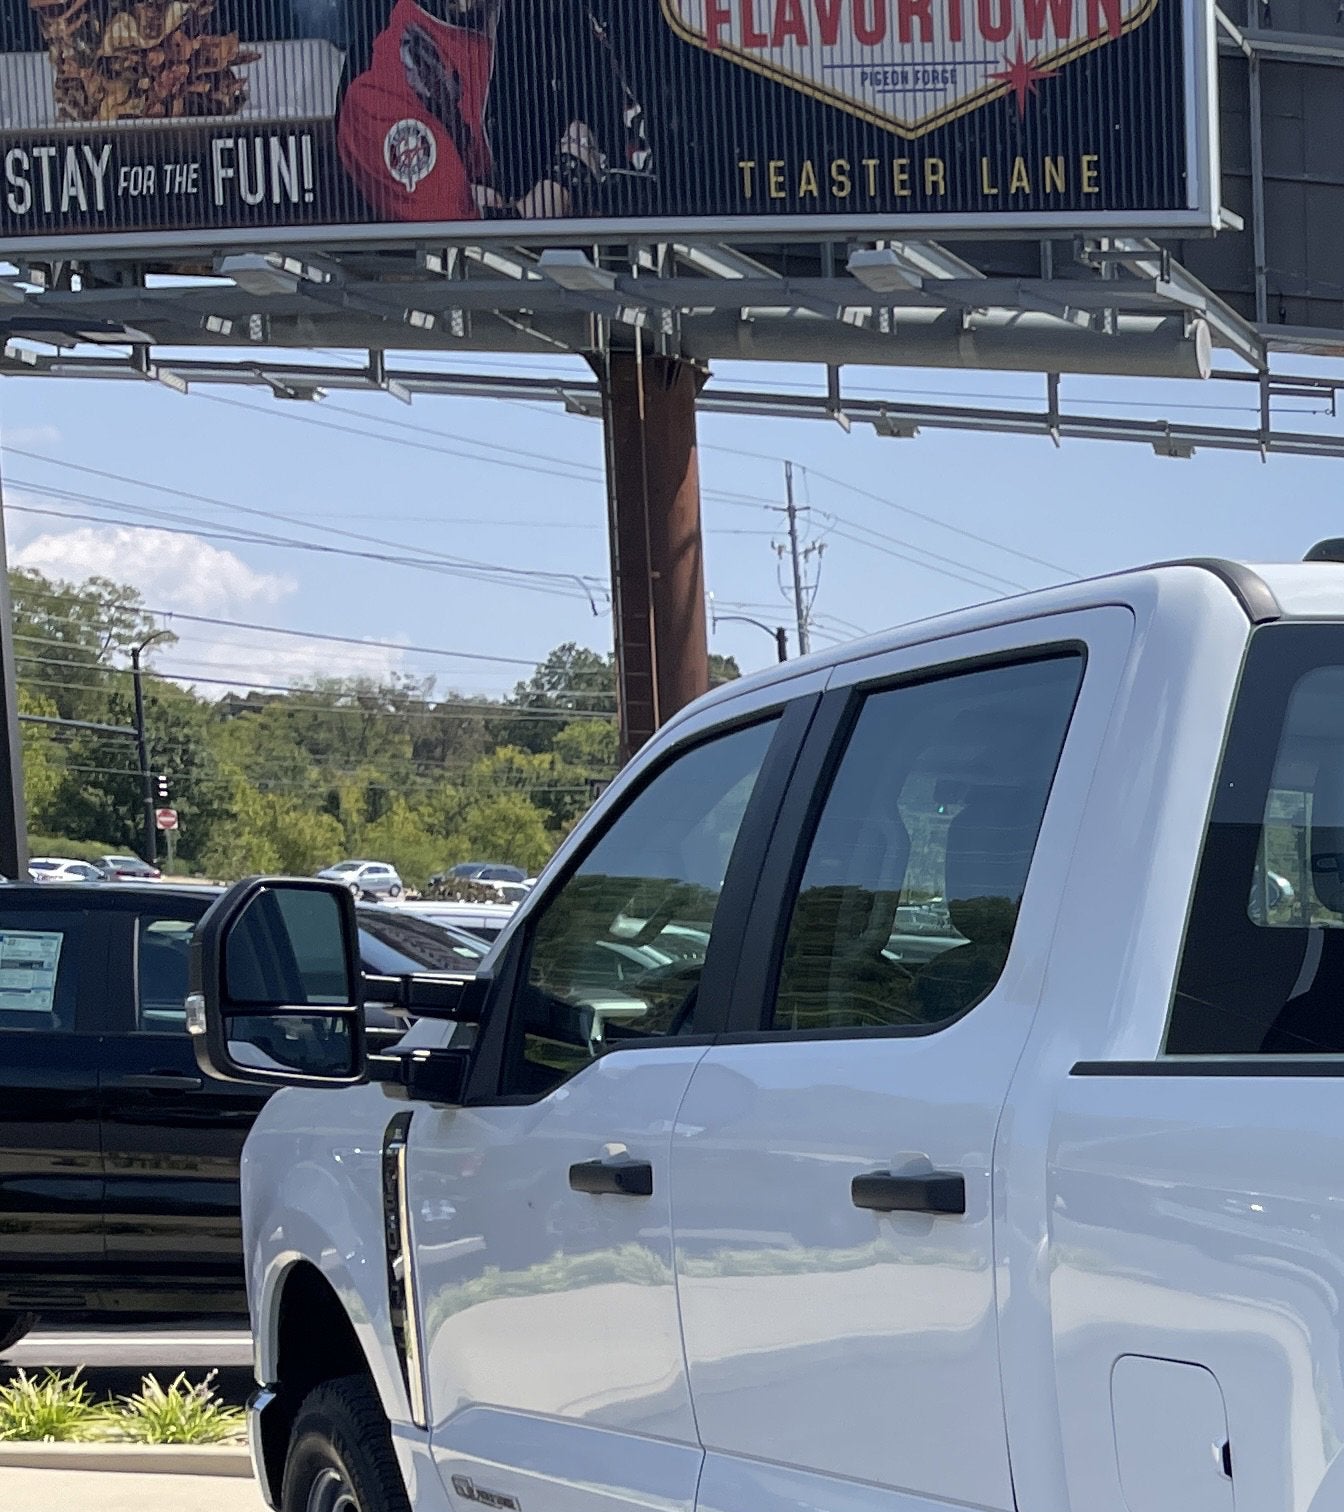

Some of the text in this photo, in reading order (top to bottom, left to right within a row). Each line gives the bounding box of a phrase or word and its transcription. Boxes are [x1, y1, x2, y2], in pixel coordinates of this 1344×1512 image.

[860, 67, 958, 88] PIGEON FORGE
[5, 134, 314, 215] STAY FOR THE FUN!
[738, 154, 1100, 200] TEASTER LANE
